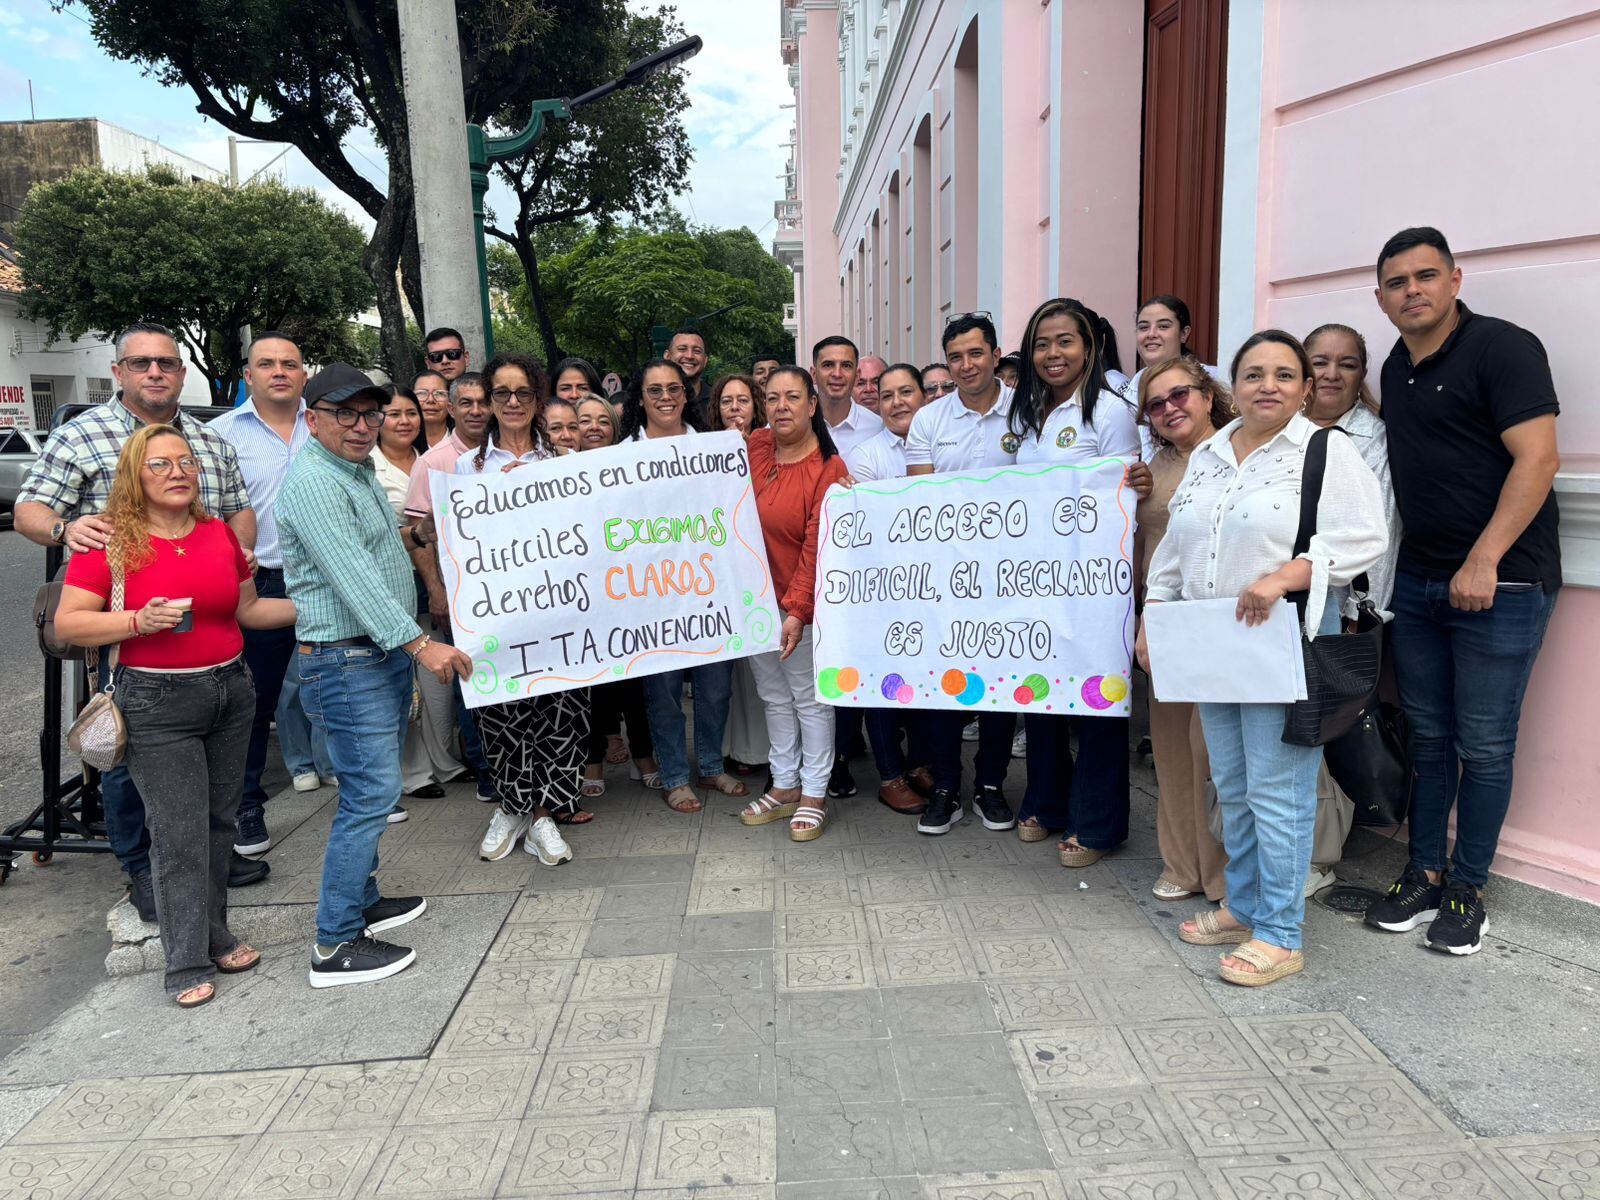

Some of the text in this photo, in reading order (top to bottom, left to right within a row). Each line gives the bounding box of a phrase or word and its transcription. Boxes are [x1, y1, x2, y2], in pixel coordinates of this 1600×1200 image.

[0, 386, 25, 403] ENDE
[450, 445, 747, 540] Educamos en condiciones
[604, 507, 727, 551] EXIGIMOS
[832, 510, 872, 548] EL
[888, 499, 1028, 542] ACCESO
[472, 553, 715, 618] derehos CLAROS
[825, 558, 1132, 604] DIFICIL, EL RECLAMO
[608, 600, 738, 658] CONVENCIÓN.
[885, 620, 1057, 661] ES JUSTO.
